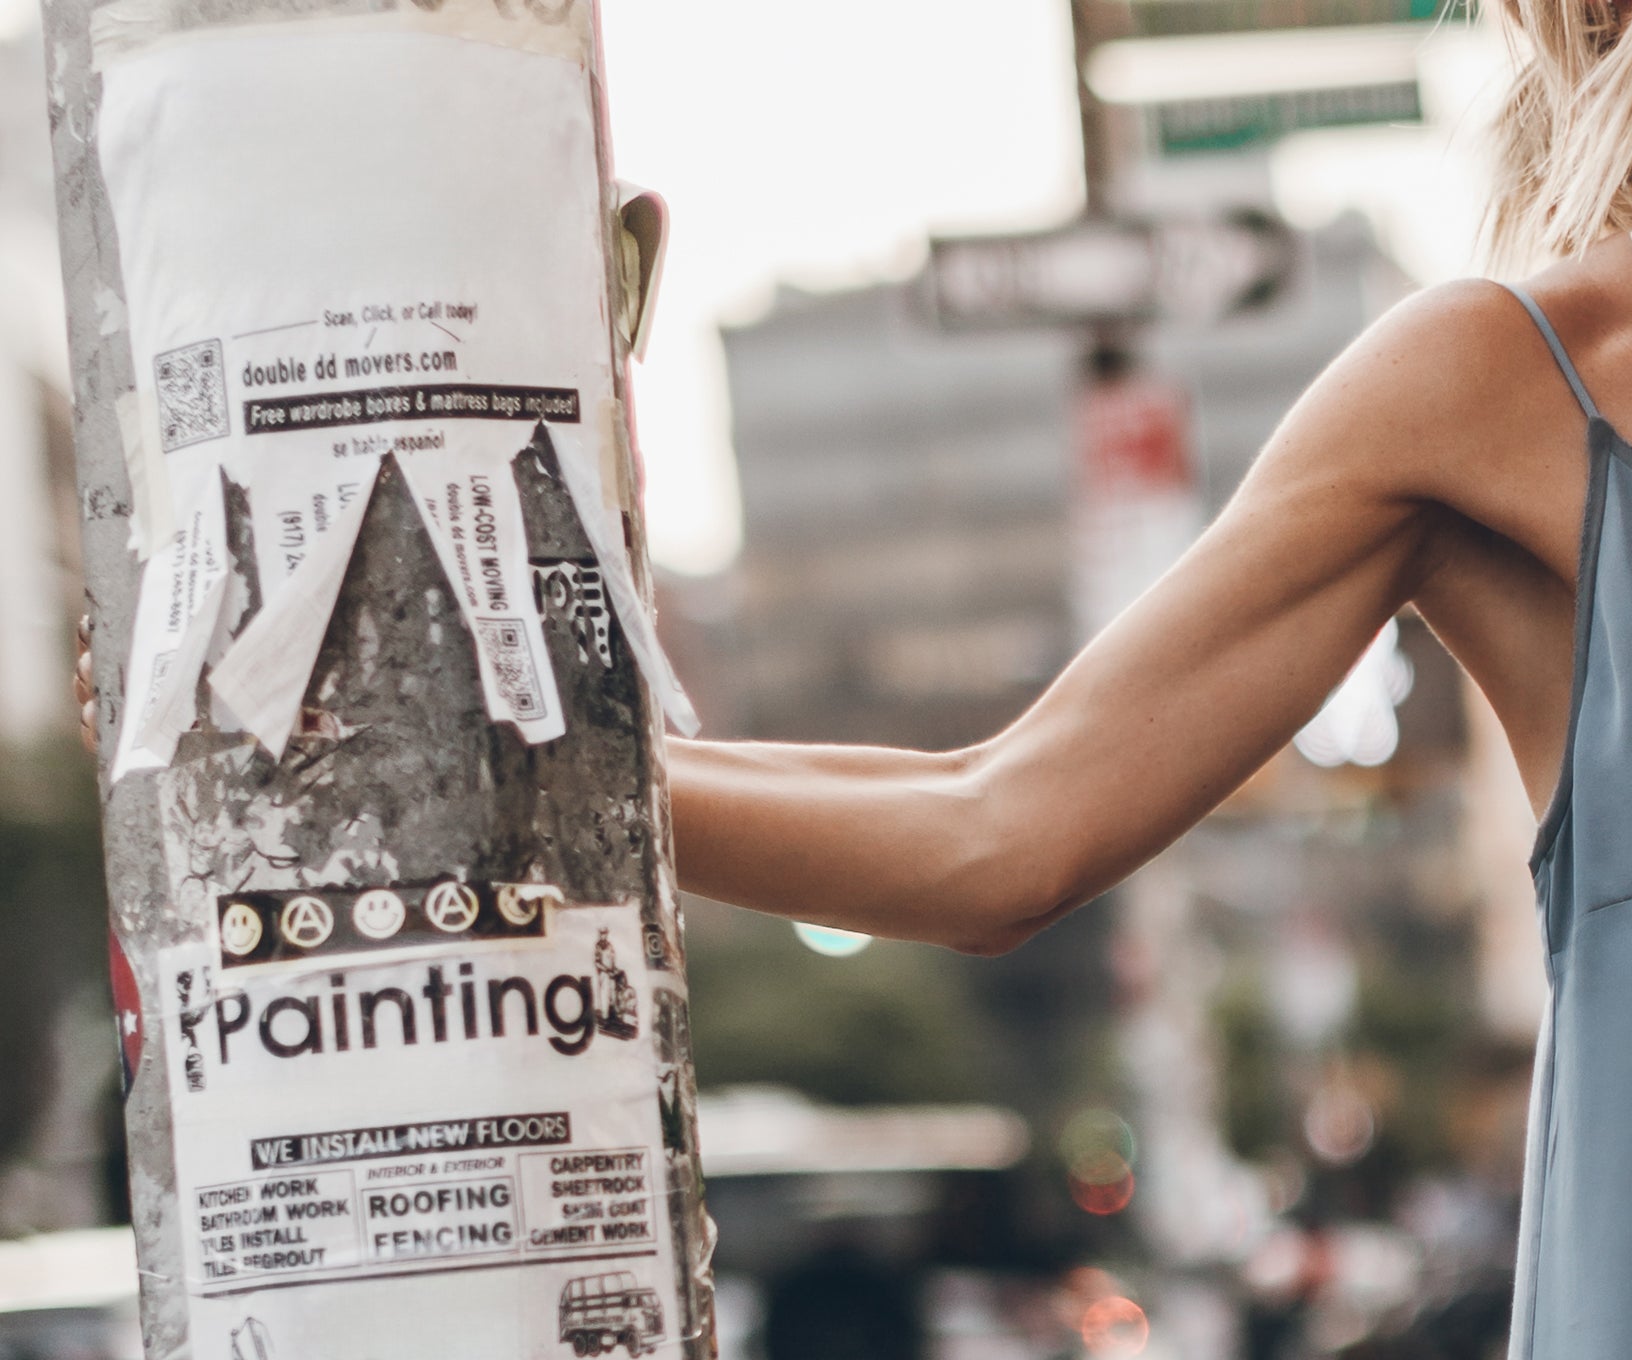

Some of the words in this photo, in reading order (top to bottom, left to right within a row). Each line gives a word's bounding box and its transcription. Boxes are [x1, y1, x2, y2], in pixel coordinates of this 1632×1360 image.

[402, 306, 414, 320] or
[418, 301, 442, 320] Call
[242, 360, 306, 387] double
[314, 352, 338, 380] dd
[344, 350, 458, 379] movers.com
[250, 404, 286, 426] Free
[289, 397, 362, 422] wardrobe
[365, 395, 411, 415] boxes
[415, 390, 427, 412] &
[429, 391, 489, 412] mattress
[491, 391, 522, 417] bags
[332, 442, 348, 458] se
[468, 474, 499, 552] LOW-COST
[479, 557, 510, 612] MOVING
[212, 962, 596, 1067] Painting
[255, 1138, 294, 1165] WE
[301, 1128, 402, 1161] INSTALL
[406, 1122, 470, 1151] NEW
[475, 1115, 567, 1144] FLOORS
[367, 1163, 425, 1181] INTERIOR
[444, 1156, 506, 1174] EXTERIOR
[549, 1153, 645, 1175] CARPENTRY
[260, 1178, 319, 1200] WORK
[368, 1184, 511, 1219] ROOFING
[284, 1198, 351, 1221] WORK
[240, 1227, 308, 1248] INSTALL
[373, 1221, 513, 1256] FENCING
[601, 1221, 650, 1241] WORK
